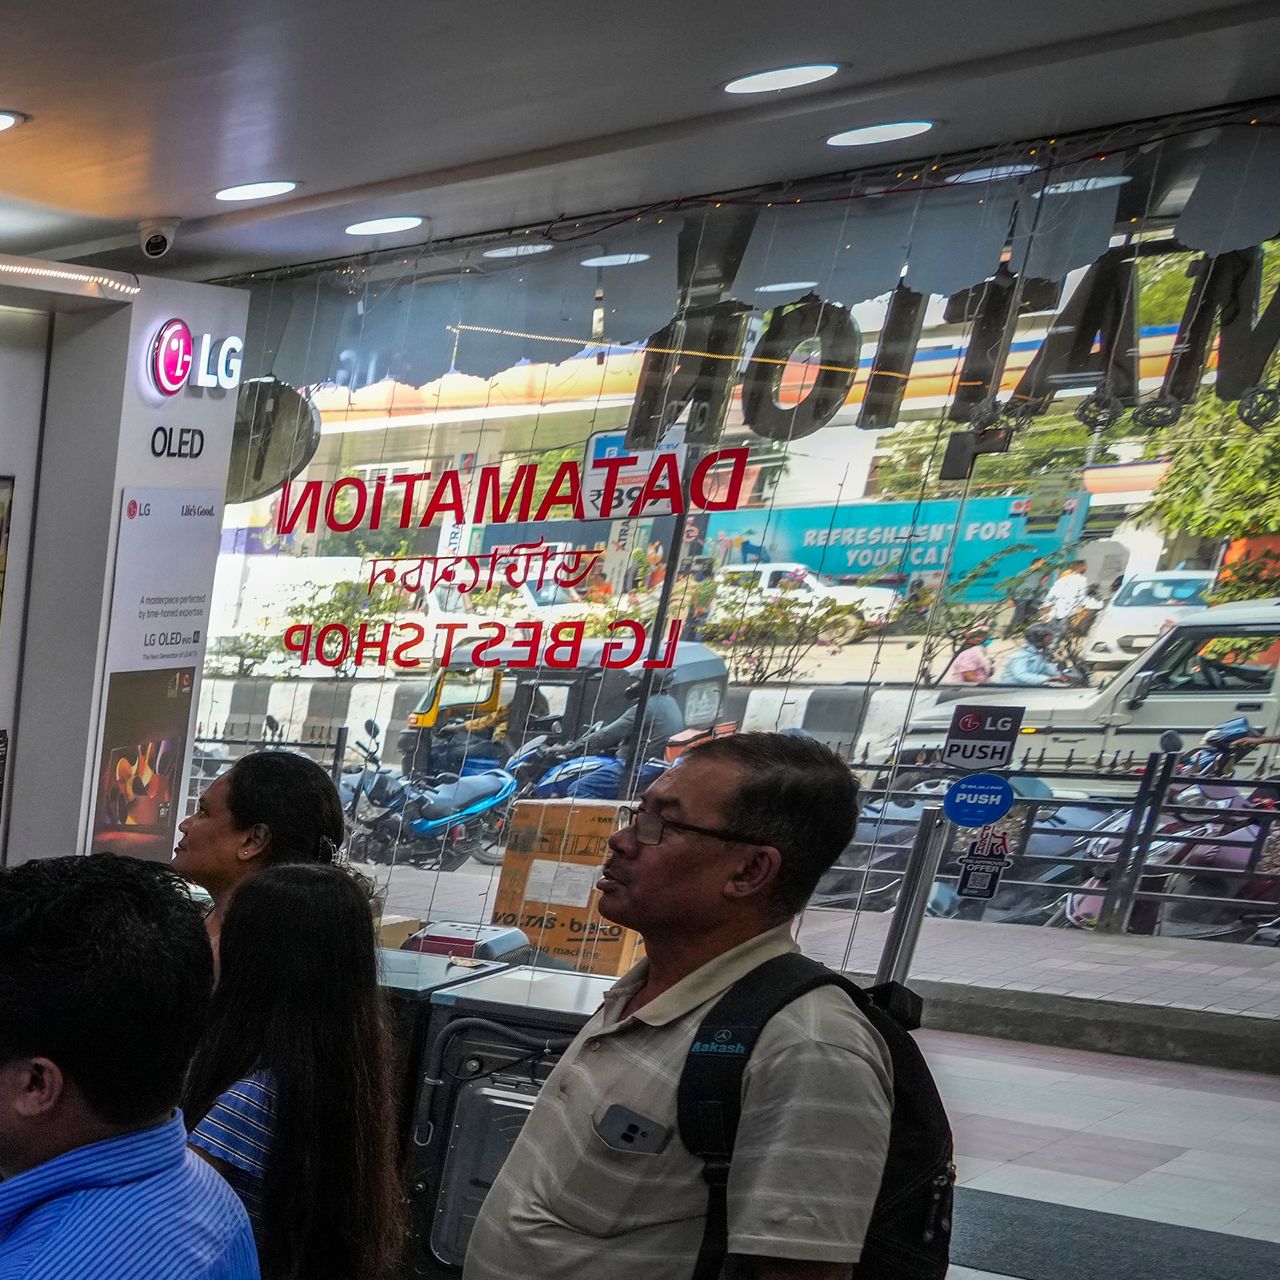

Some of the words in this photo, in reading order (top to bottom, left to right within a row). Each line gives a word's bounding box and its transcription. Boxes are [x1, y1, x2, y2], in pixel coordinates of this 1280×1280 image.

[200, 333, 243, 390] LG
[151, 425, 205, 459] OLED
[138, 503, 151, 517] LG
[181, 505, 196, 517] Life's
[196, 505, 215, 517] Good.
[965, 521, 1012, 541] FOR
[984, 717, 1013, 731] LG
[946, 744, 1006, 760] PUSH
[955, 792, 1002, 805] PUSH
[966, 864, 1000, 873] OFFER
[492, 911, 557, 930] VOLTAS
[570, 918, 623, 937] beko
[553, 945, 599, 958] machine
